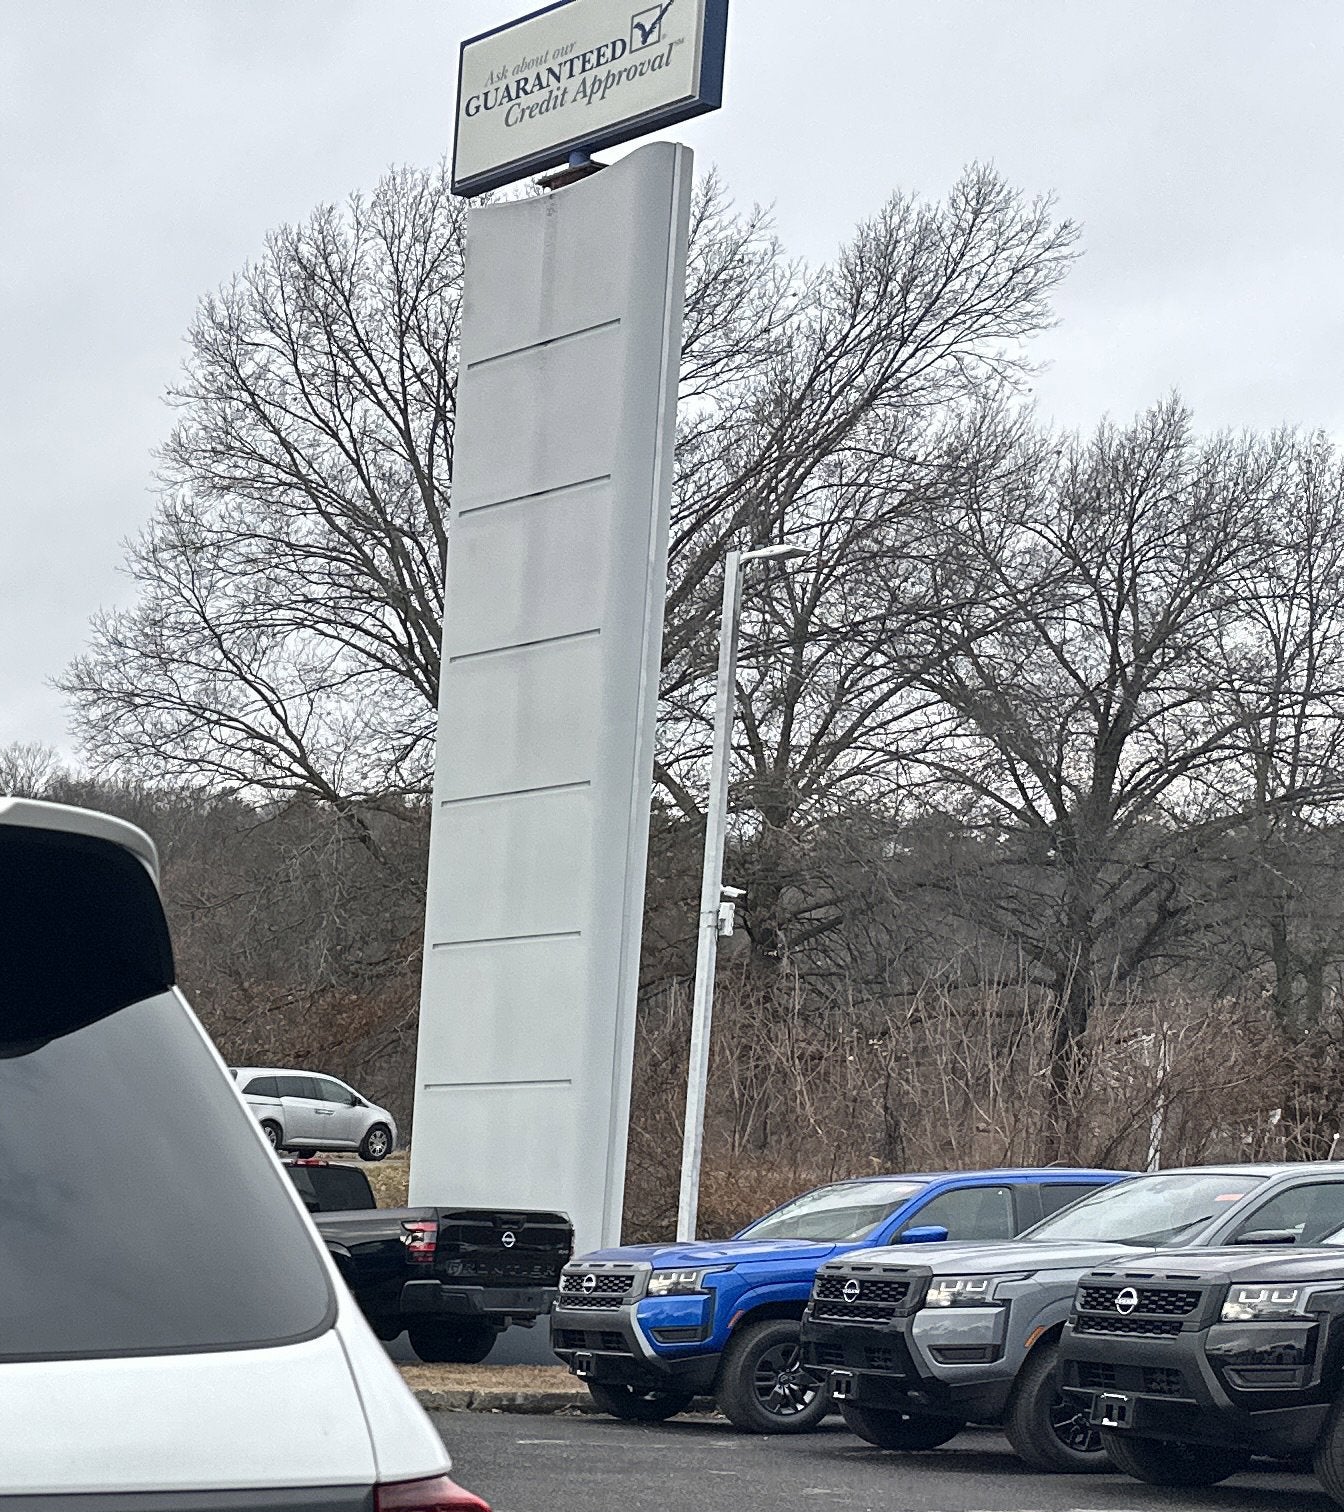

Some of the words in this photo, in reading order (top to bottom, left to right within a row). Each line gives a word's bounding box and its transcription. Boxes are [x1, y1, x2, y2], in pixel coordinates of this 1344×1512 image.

[464, 38, 627, 118] GUARANTEED
[484, 64, 509, 87] Ask
[512, 49, 549, 76] about
[552, 41, 577, 60] our
[504, 86, 568, 127] Credit
[571, 42, 674, 106] Approval
